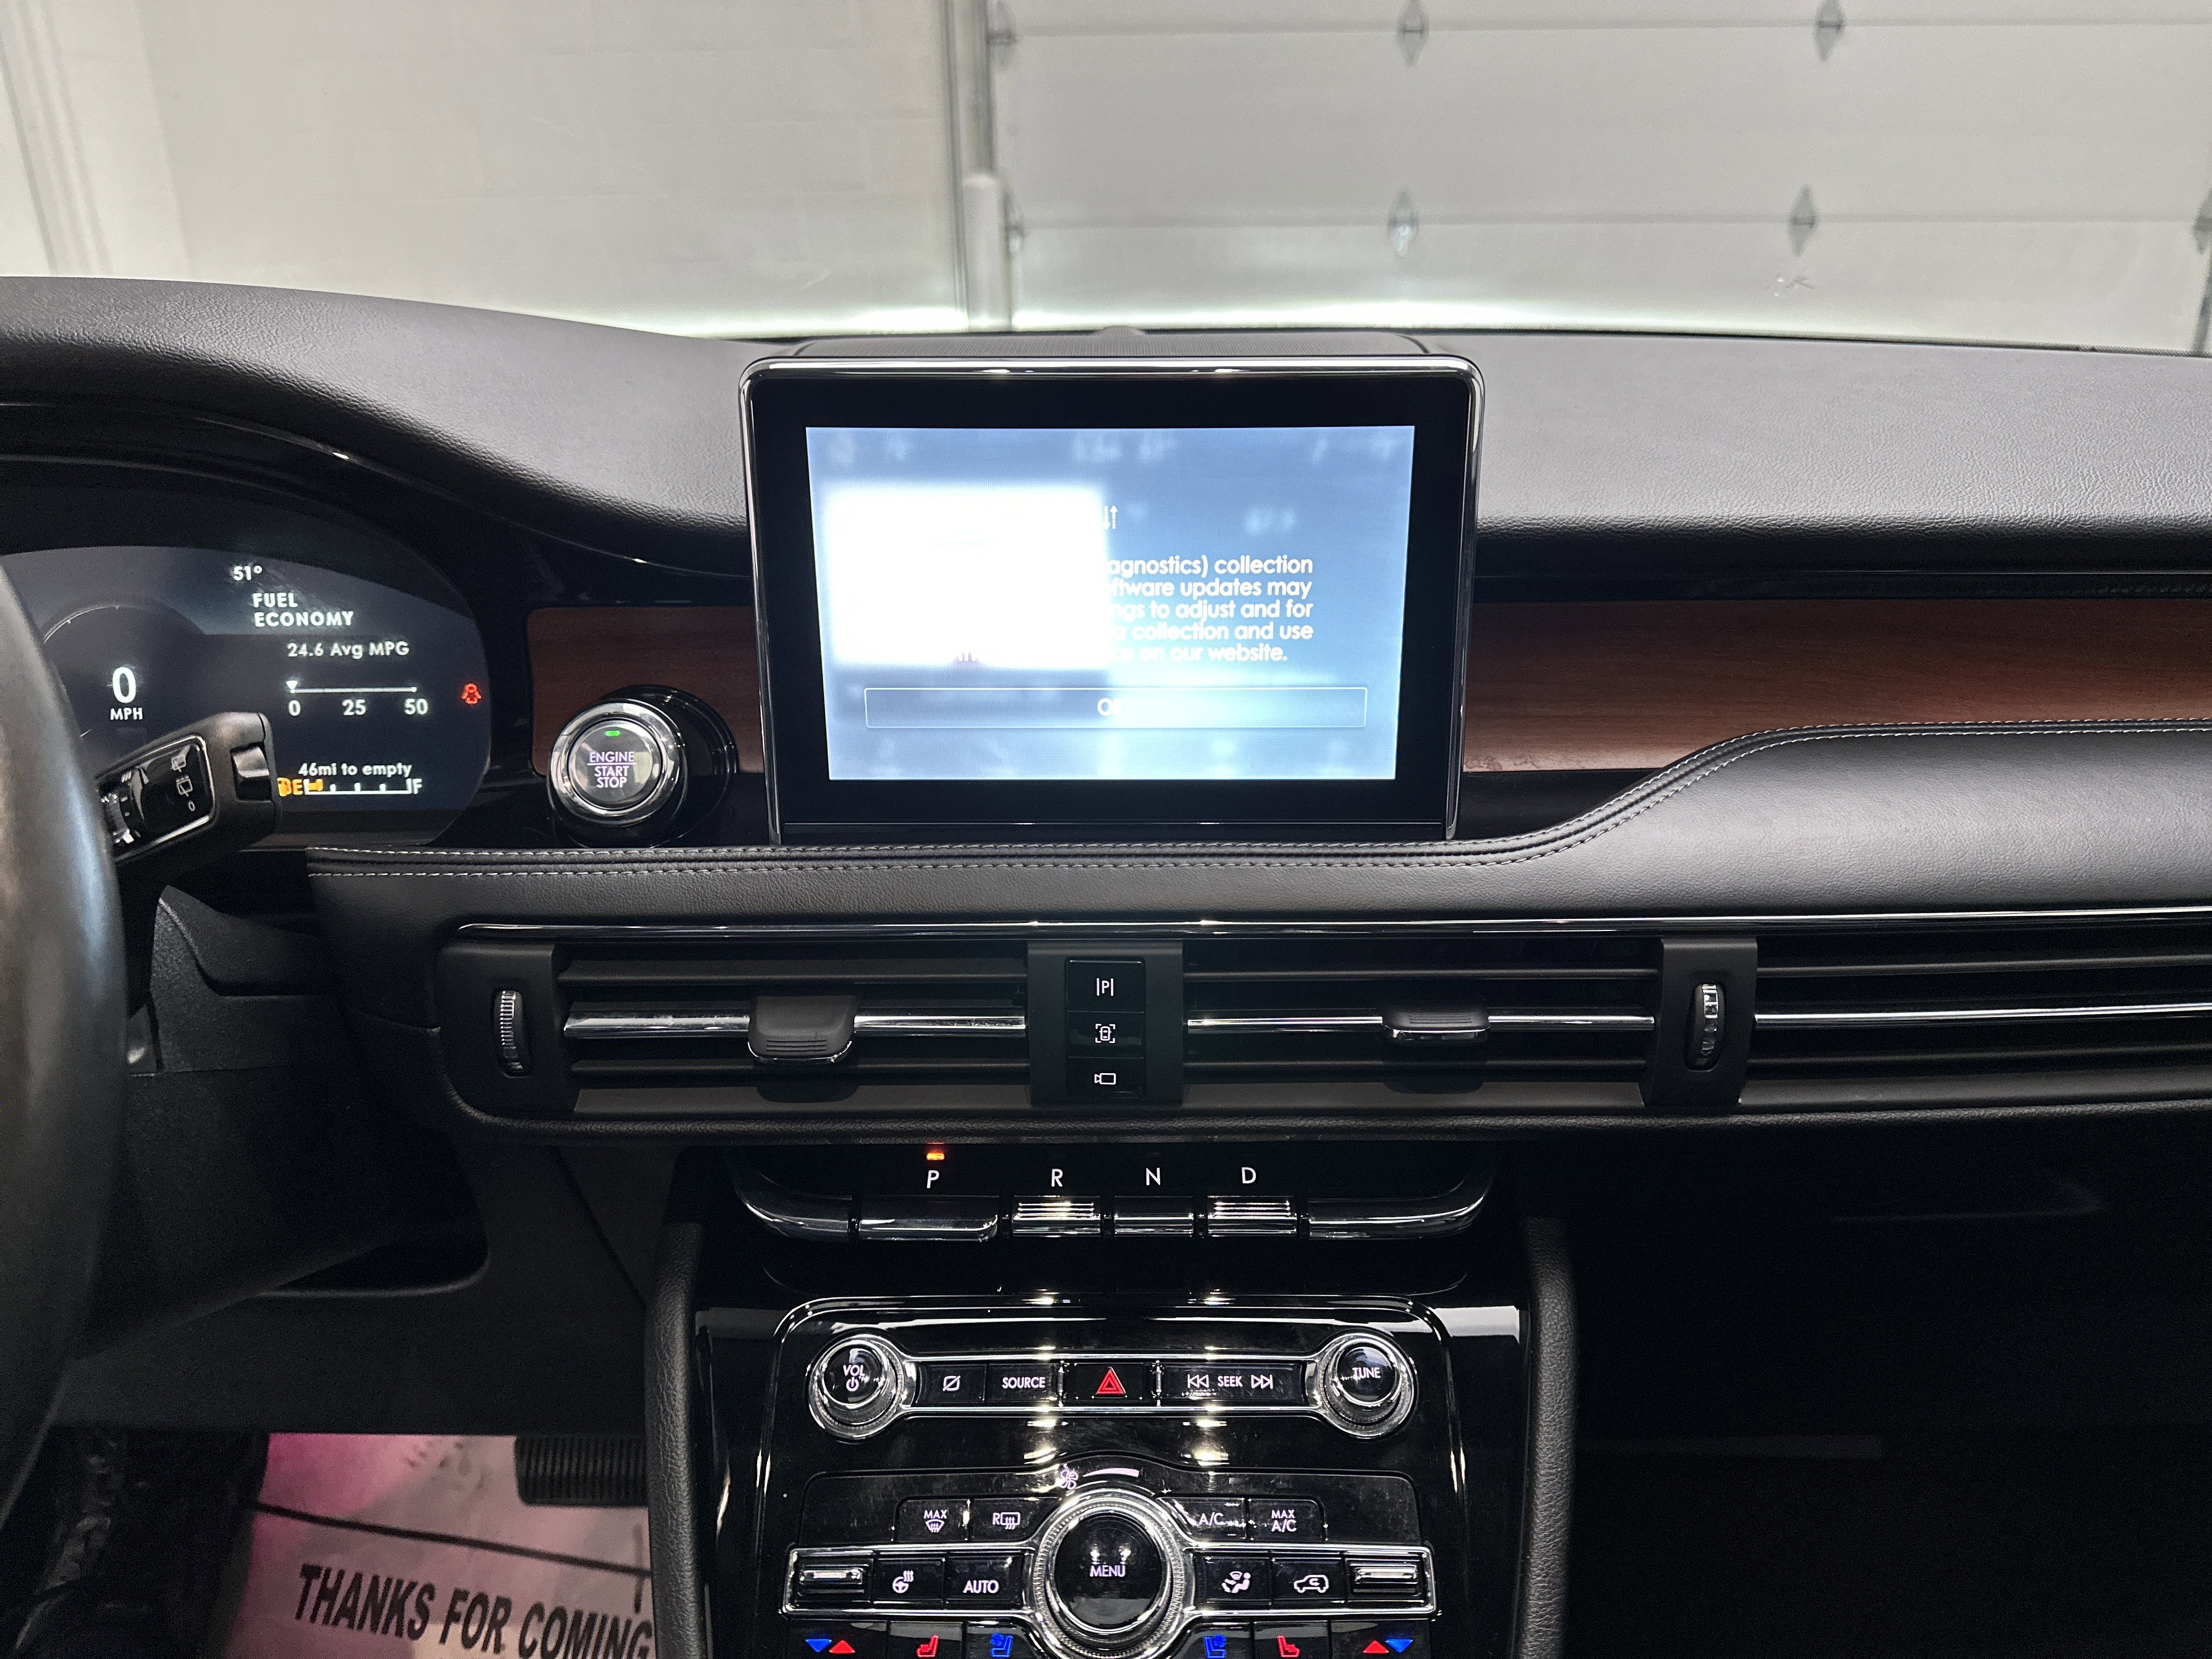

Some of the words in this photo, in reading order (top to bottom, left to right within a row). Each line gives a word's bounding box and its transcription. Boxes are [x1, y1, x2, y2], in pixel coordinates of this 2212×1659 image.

[1107, 555, 1208, 578] agnostics)
[1214, 555, 1312, 574] collection
[1111, 578, 1175, 596] ftware
[1180, 578, 1262, 600] updates
[1267, 581, 1312, 600] may
[252, 592, 298, 608] FUEL
[254, 611, 354, 627] ECONOMY
[1150, 600, 1170, 618] to
[1175, 599, 1236, 623] adjust
[1240, 599, 1280, 618] and
[1285, 599, 1314, 618] for
[1131, 622, 1229, 640] collection
[1234, 621, 1273, 640] and
[1279, 624, 1314, 640] use
[287, 642, 324, 657] 24.6
[330, 643, 363, 659] Avg
[368, 641, 409, 656] MPG
[1139, 647, 1164, 662] on
[1170, 647, 1203, 662] our
[1209, 642, 1288, 662] website.
[112, 666, 136, 703] 0
[110, 707, 143, 720] MPH
[288, 699, 301, 716] 0
[342, 699, 366, 715] 25
[404, 698, 428, 715] 50
[589, 751, 635, 763] ENGINE
[298, 762, 337, 776] 46mi
[341, 763, 358, 776] to
[362, 762, 412, 778] empty
[594, 765, 629, 777] START
[412, 777, 422, 794] F
[596, 777, 627, 789] STOP
[926, 1170, 940, 1189] P
[1051, 1168, 1064, 1187] R
[1146, 1167, 1161, 1186] N
[1241, 1166, 1257, 1184] D
[843, 1364, 866, 1377] VOL
[1352, 1366, 1381, 1379] TUNE
[1001, 1376, 1046, 1389] SOURCE
[1217, 1375, 1243, 1388] SEEK
[924, 1509, 947, 1520] MAX
[1198, 1511, 1224, 1526] A/C
[1271, 1509, 1295, 1519] MAX
[1271, 1519, 1297, 1533] A/C
[1090, 1565, 1126, 1578] MENU
[963, 1579, 999, 1594] AUTO
[295, 1564, 436, 1641] THANKS
[439, 1588, 512, 1655] FOR
[517, 1600, 652, 1659] COMING
